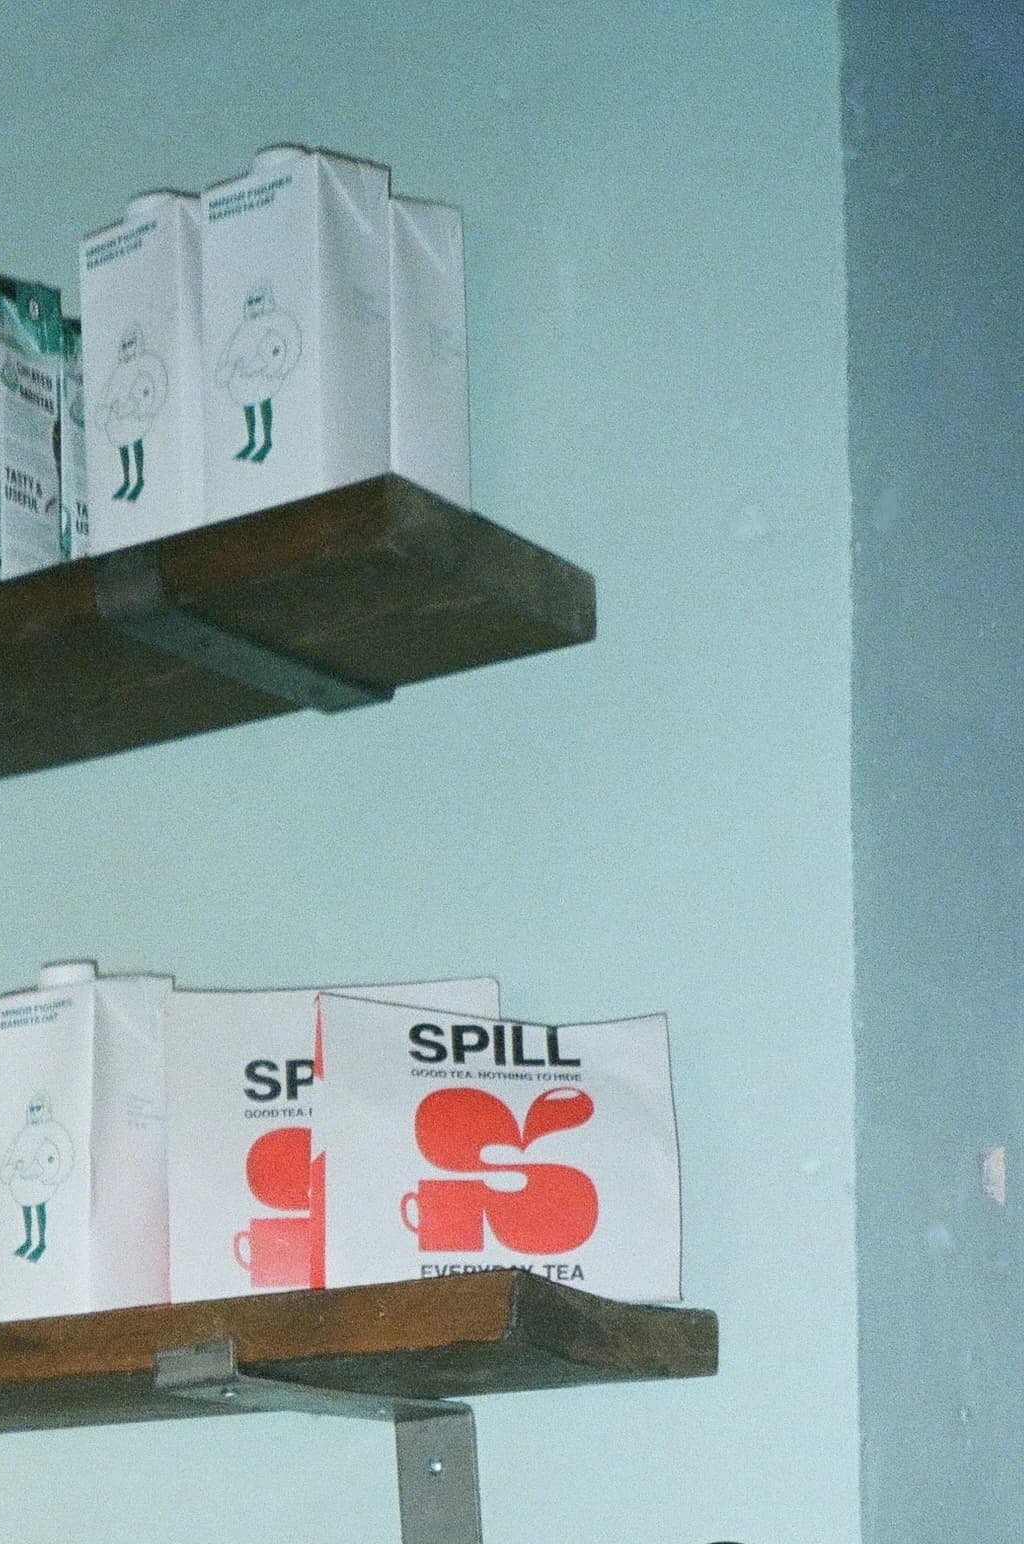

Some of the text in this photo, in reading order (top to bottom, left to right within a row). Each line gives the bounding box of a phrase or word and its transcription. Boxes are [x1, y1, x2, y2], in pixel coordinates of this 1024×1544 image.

[0, 1015, 40, 1030] BARISTA
[408, 1023, 582, 1067] SPILL
[411, 1068, 447, 1079] GOOD
[478, 1071, 534, 1081] NOTHING
[536, 1071, 552, 1081] TO
[553, 1072, 583, 1082] HIDE
[244, 1108, 279, 1119] GOOD
[543, 1264, 585, 1281] TEA
